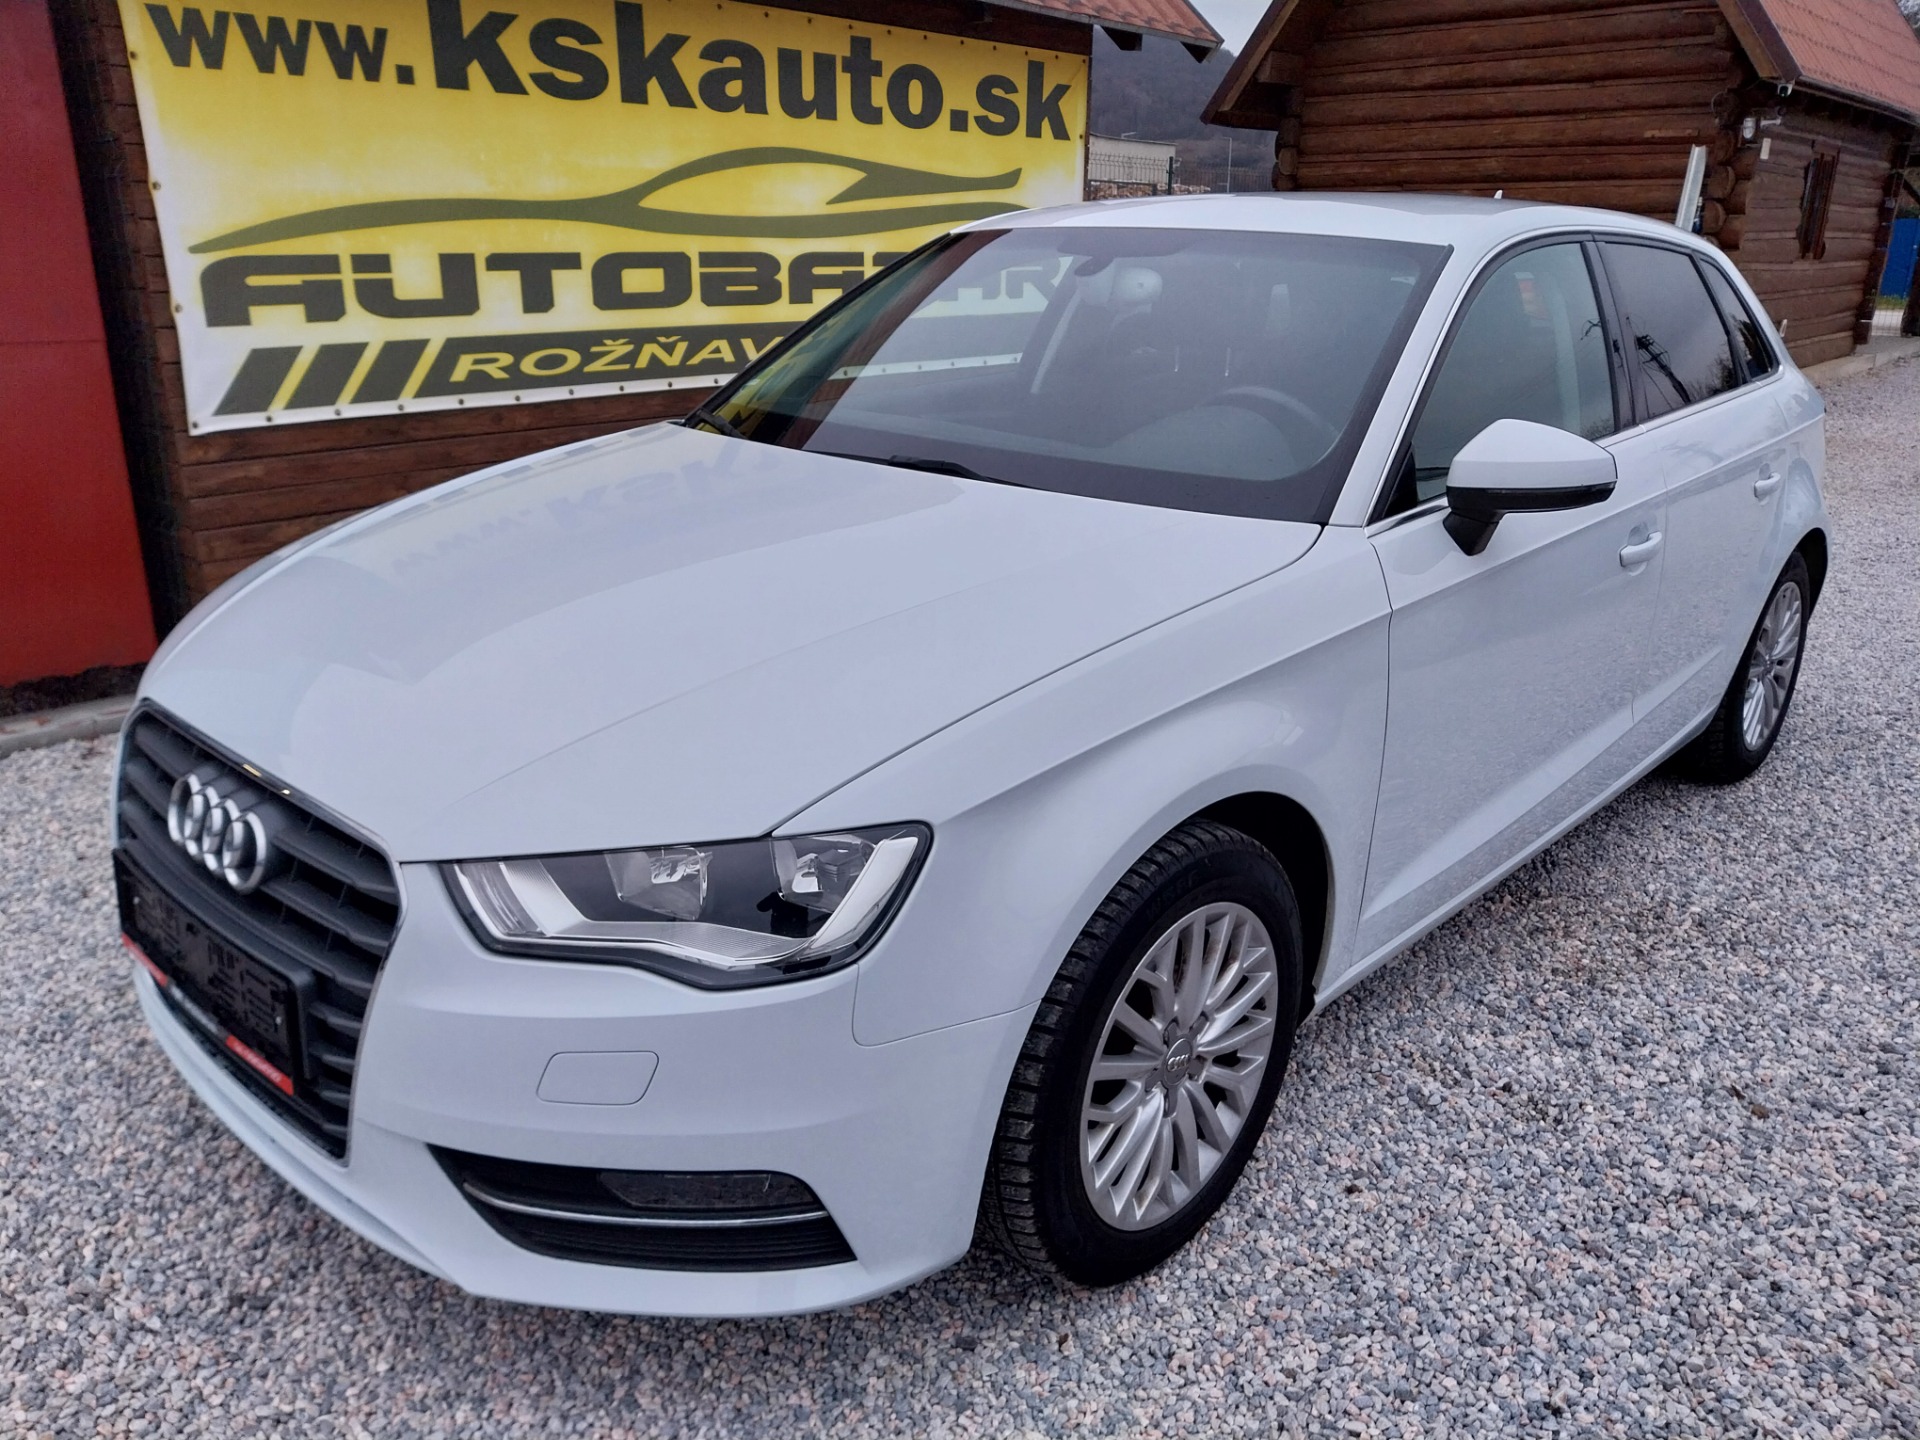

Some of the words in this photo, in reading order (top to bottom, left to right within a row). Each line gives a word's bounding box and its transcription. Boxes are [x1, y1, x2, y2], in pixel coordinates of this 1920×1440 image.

[144, 0, 1071, 141] www.kskauto.sk
[200, 251, 1060, 327] AUTOBAR
[449, 336, 784, 383] ROŽŇAV
